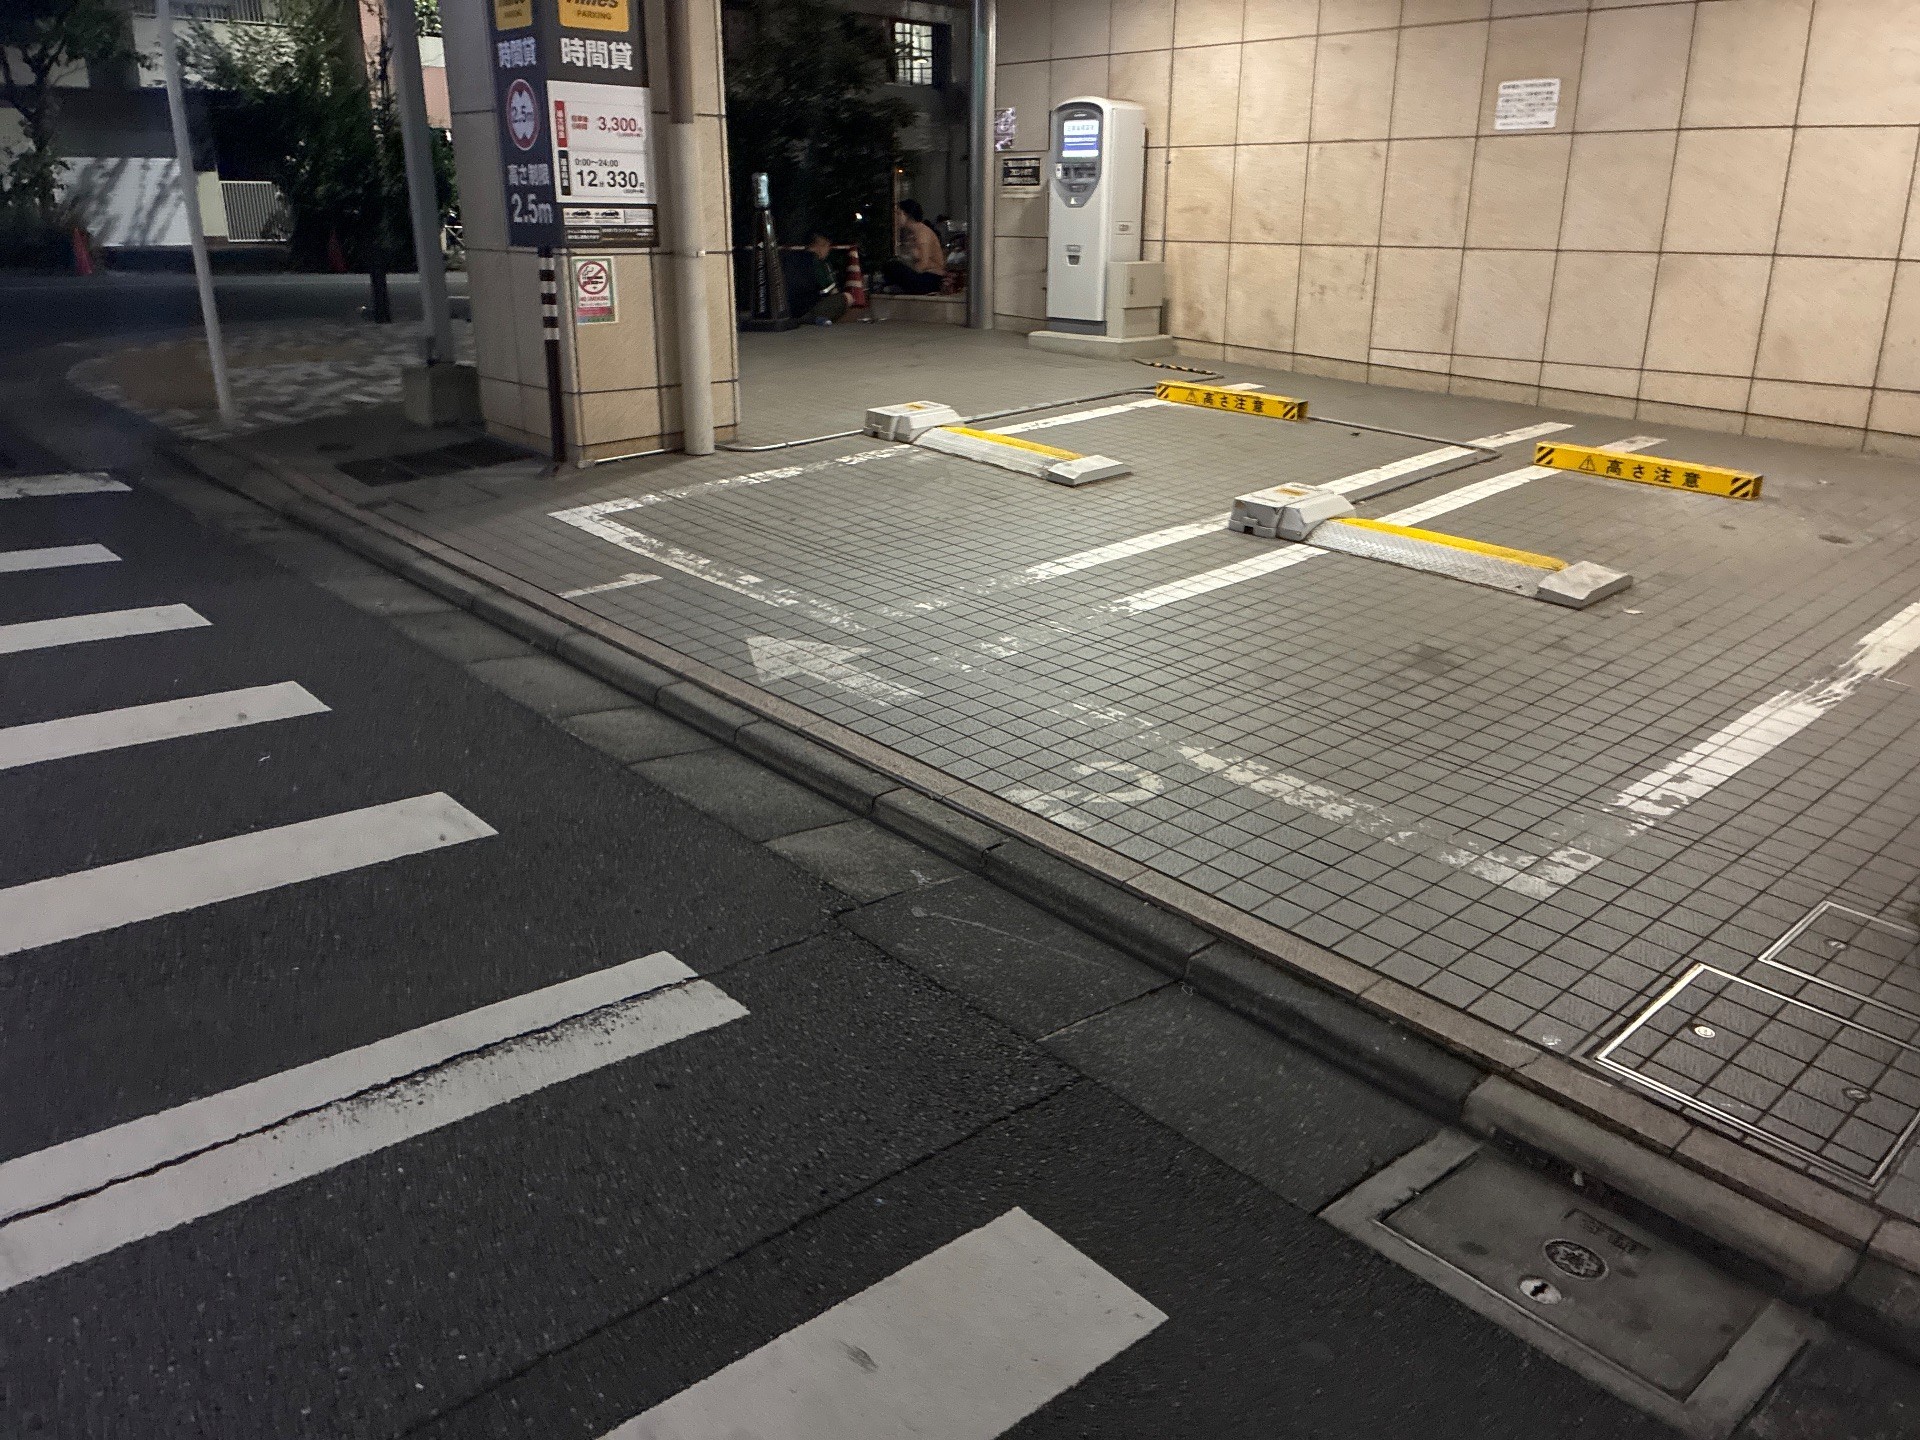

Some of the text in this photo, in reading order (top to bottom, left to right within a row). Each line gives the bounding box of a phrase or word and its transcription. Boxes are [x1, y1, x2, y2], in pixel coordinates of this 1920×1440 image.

[497, 37, 537, 68] 時間貸
[560, 38, 633, 70] 時間貸
[512, 193, 553, 224] 2.5m
[1203, 391, 1265, 413] 高さ注意
[1606, 458, 1701, 489] 高さ注意
